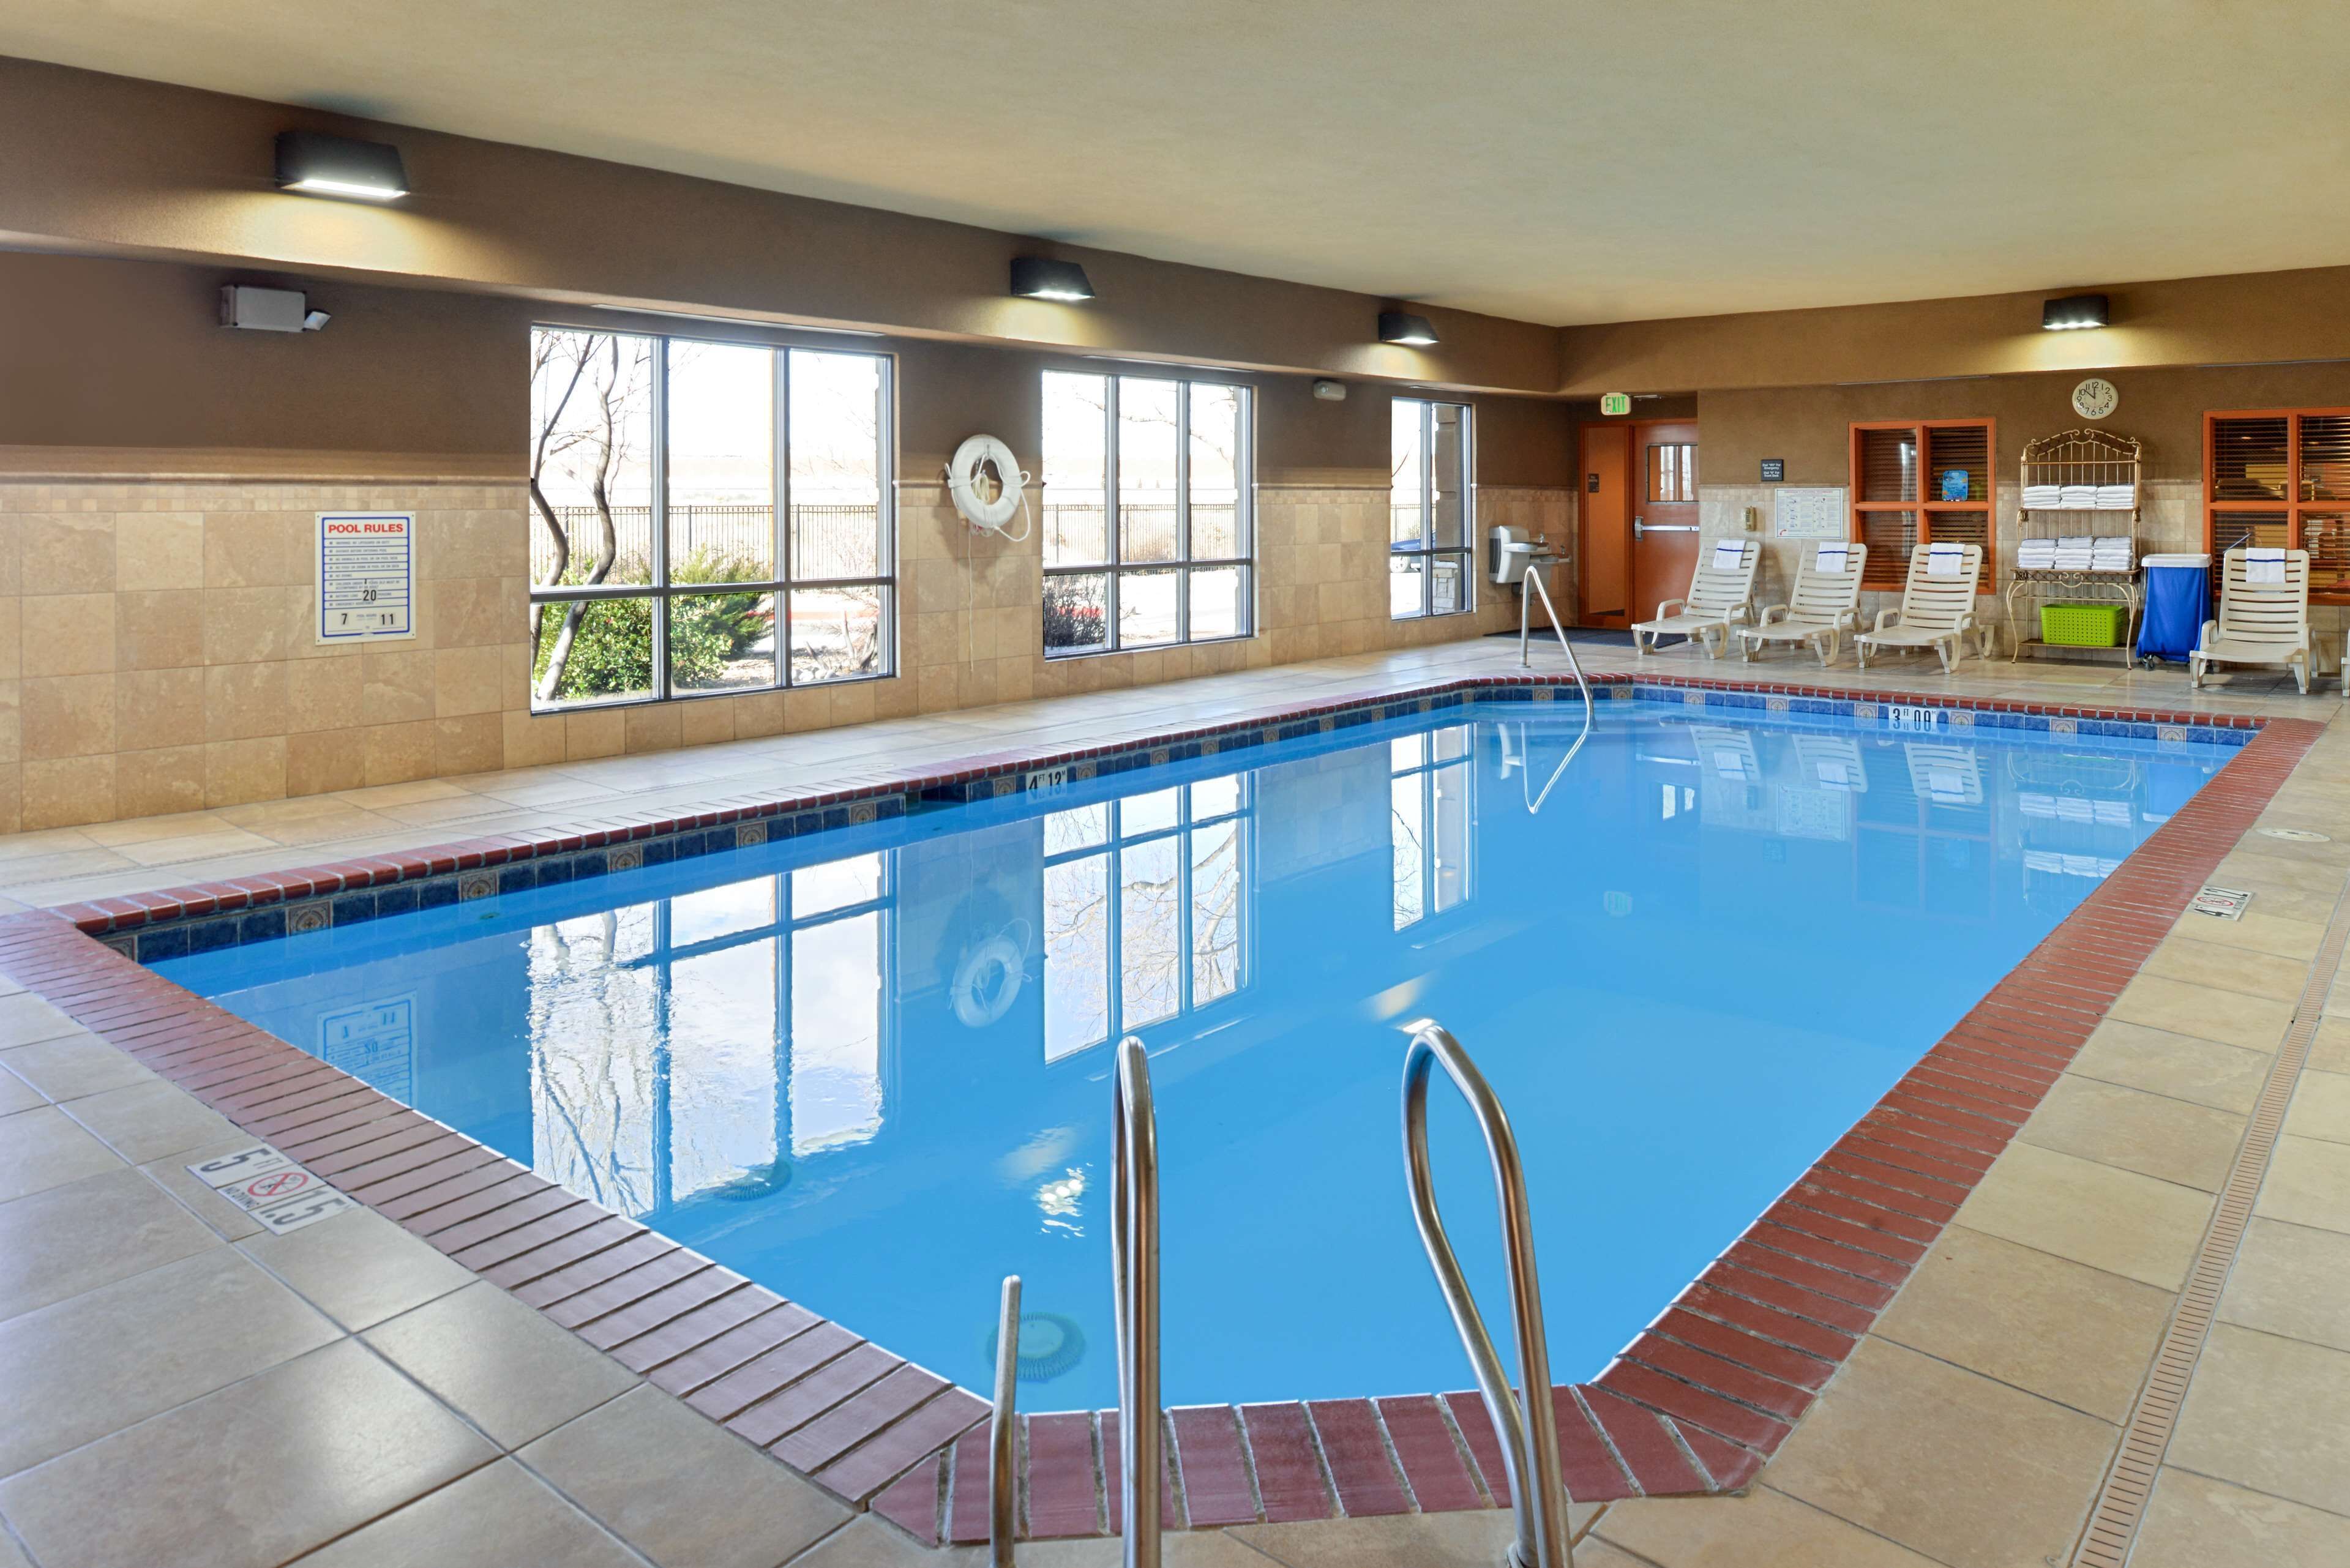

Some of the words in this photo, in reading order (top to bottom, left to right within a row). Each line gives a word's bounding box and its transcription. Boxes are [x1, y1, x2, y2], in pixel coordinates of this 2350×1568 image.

[1606, 396, 1626, 413] EXIT
[328, 524, 361, 533] POOL
[364, 524, 403, 533] RULES
[363, 589, 376, 601] 20
[341, 613, 348, 625] 7
[381, 613, 394, 625] 11
[1893, 707, 1901, 721] 3
[1903, 708, 1909, 717] FT
[1028, 775, 1038, 790] 4
[1038, 774, 1046, 782] FT
[200, 1148, 272, 1173] 5
[259, 1190, 347, 1226] 1.5
